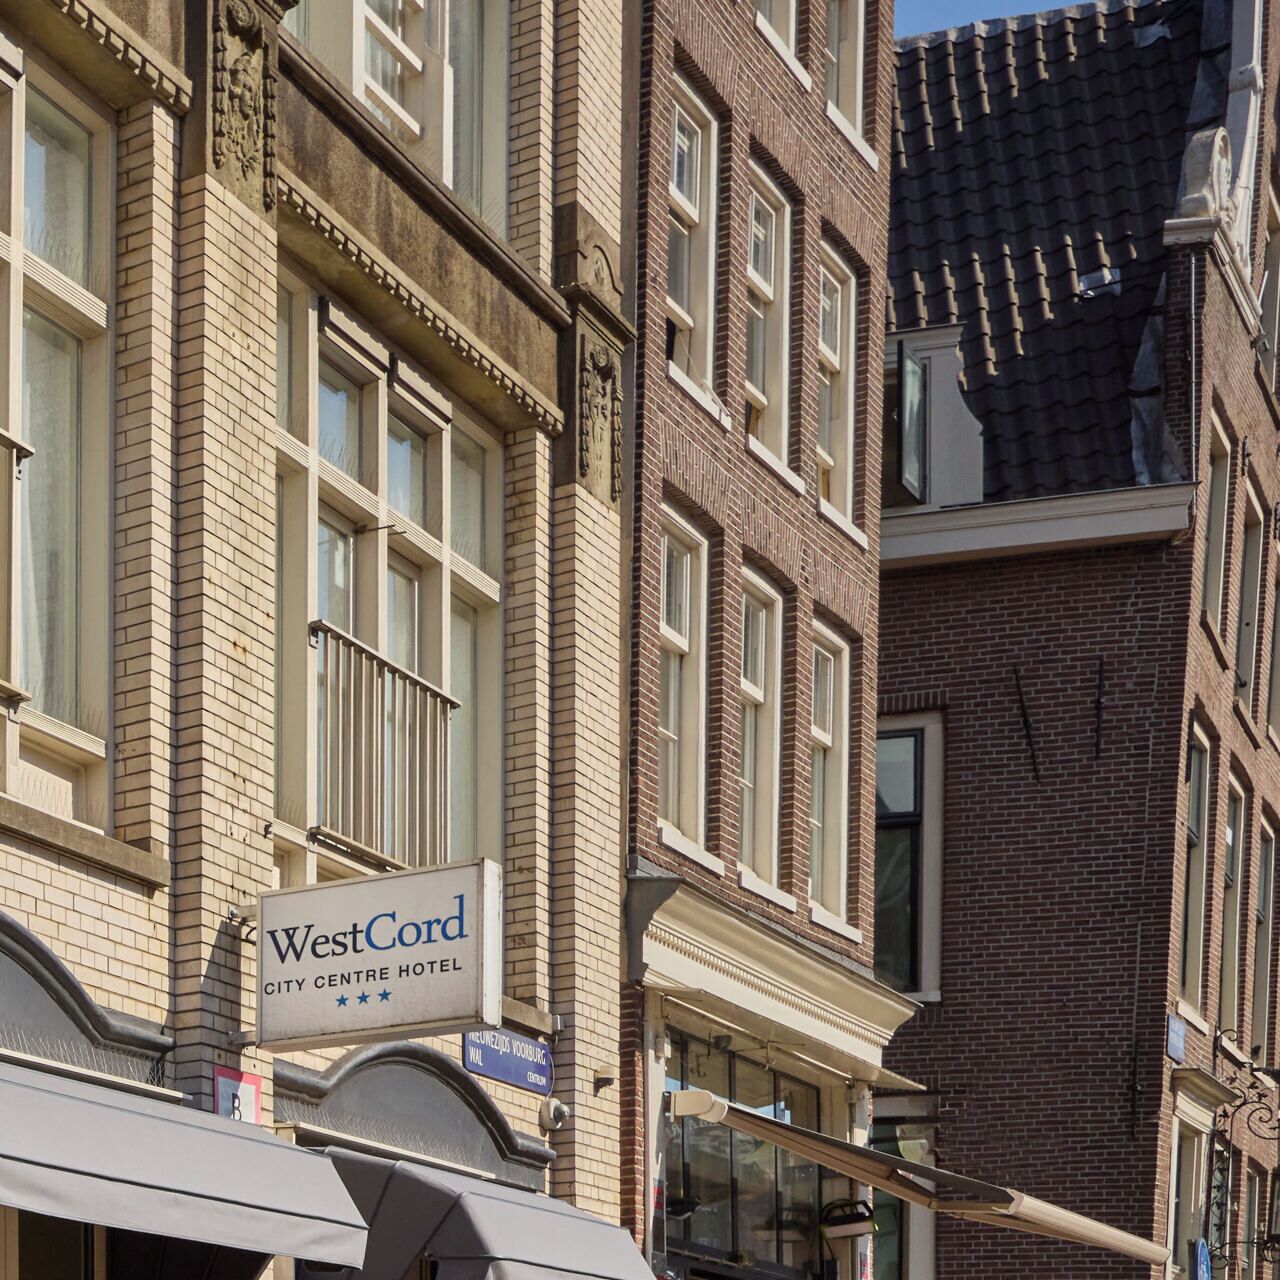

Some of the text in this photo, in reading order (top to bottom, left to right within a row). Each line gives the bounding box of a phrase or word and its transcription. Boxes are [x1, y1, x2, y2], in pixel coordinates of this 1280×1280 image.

[266, 894, 469, 964] WestCord
[264, 957, 463, 996] CITY CENTRE HOTEL
[469, 1046, 483, 1066] WAL
[512, 1039, 546, 1065] VOORBURG
